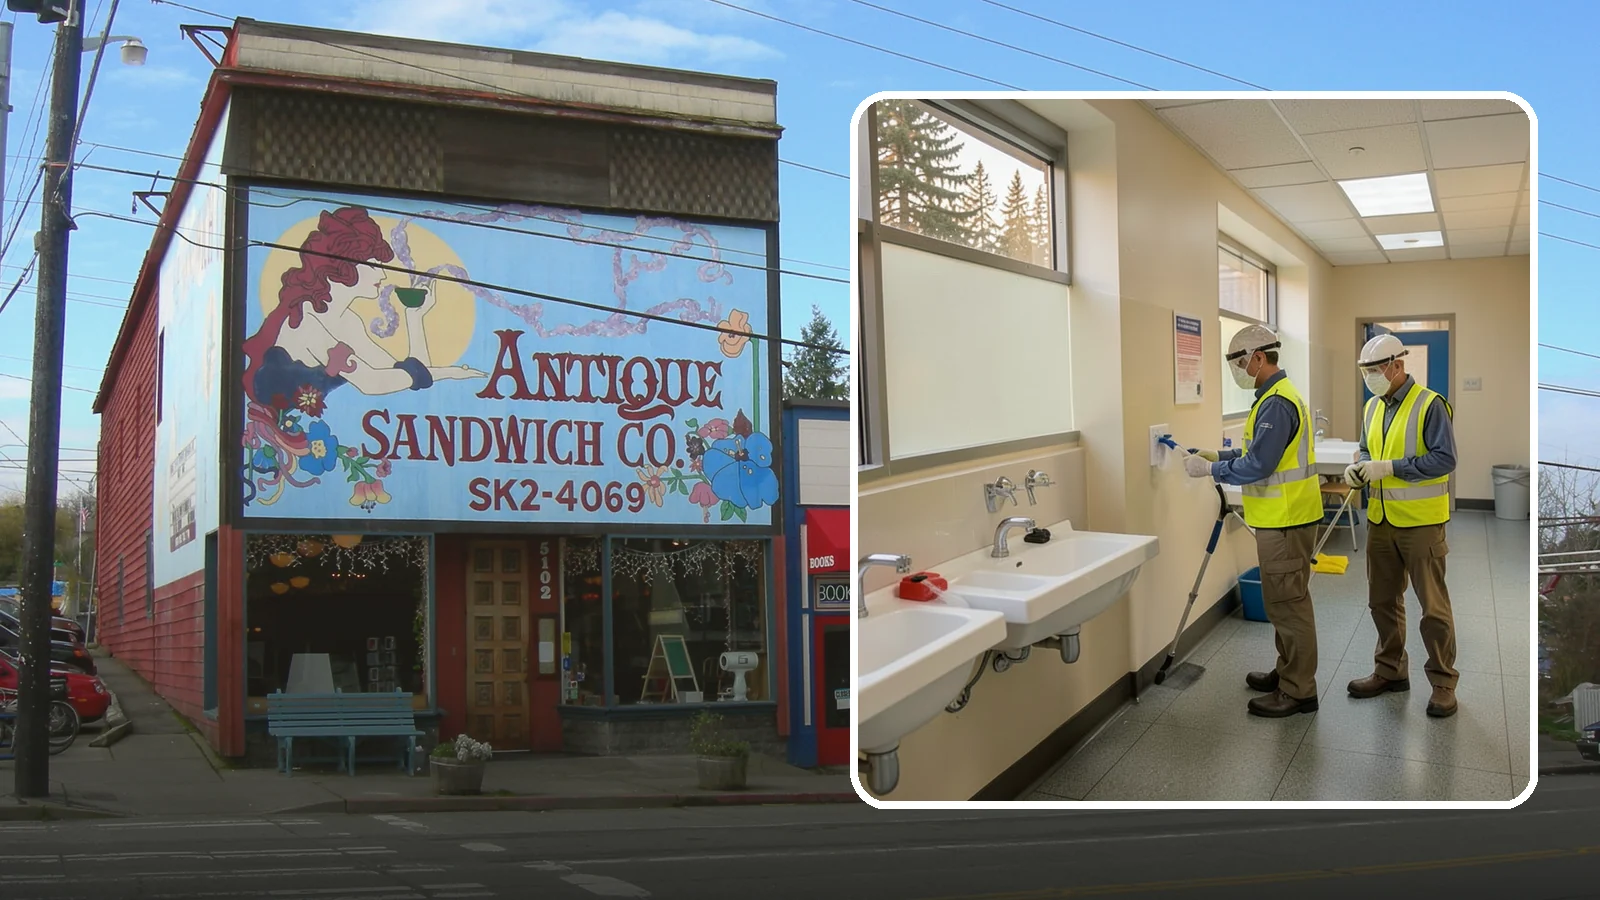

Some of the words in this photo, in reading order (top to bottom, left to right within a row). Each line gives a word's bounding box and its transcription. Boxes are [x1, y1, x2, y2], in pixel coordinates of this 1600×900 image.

[475, 329, 724, 421] ANTIQUE
[361, 408, 605, 467] SANDWICH
[617, 421, 685, 468] CO.
[468, 477, 646, 513] SK2-4069
[539, 541, 552, 600] 5102
[809, 555, 835, 569] BOOKS
